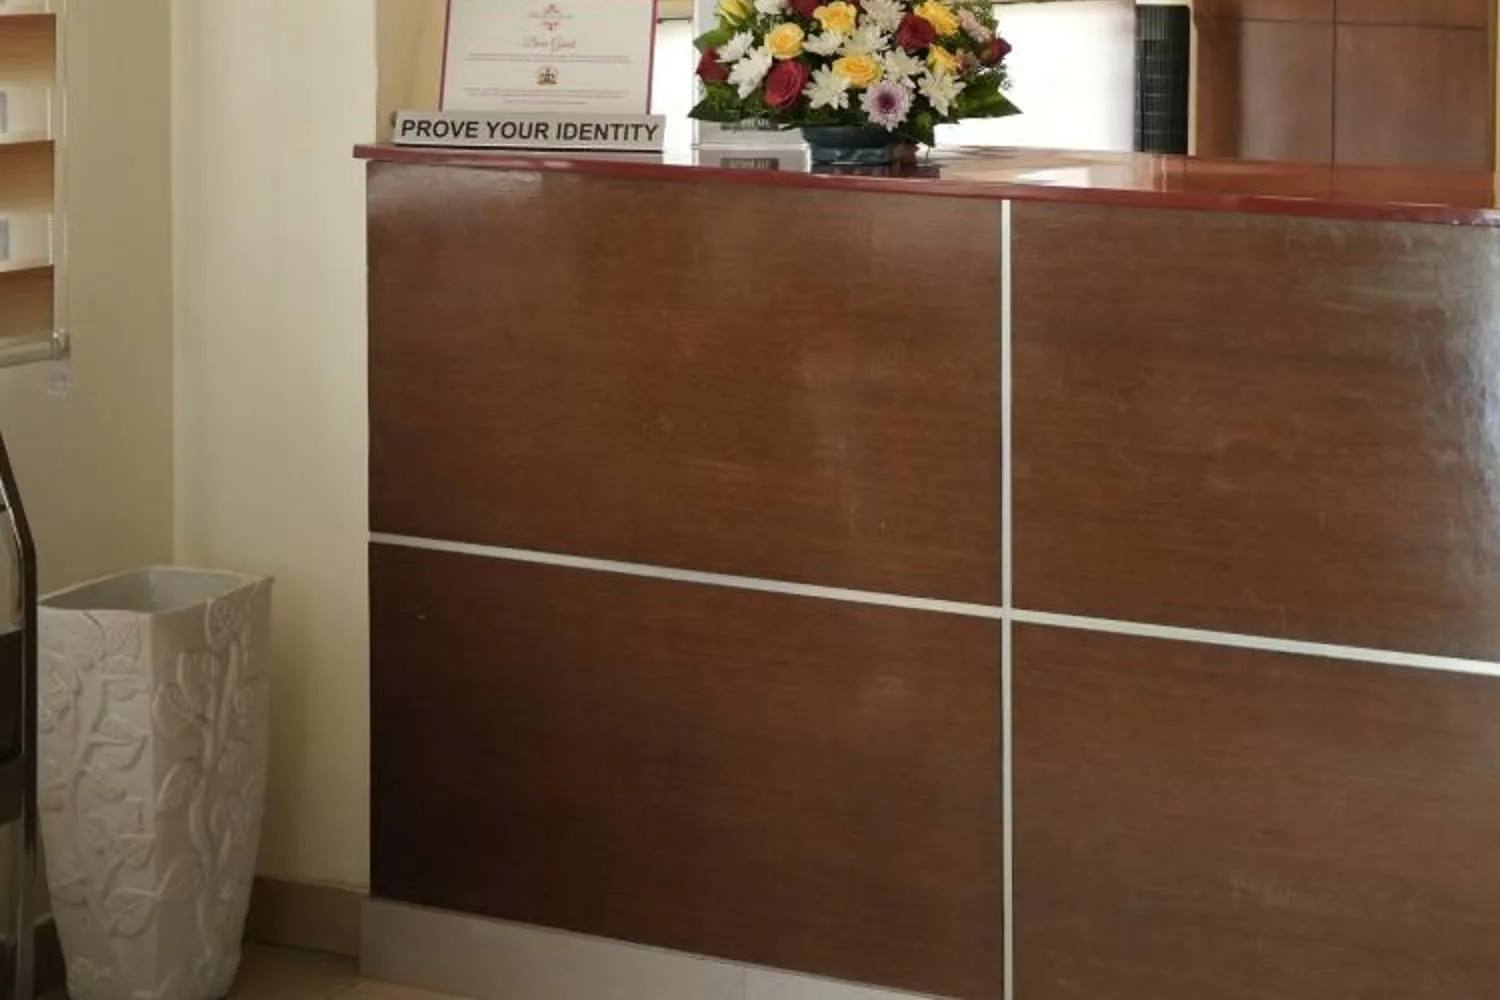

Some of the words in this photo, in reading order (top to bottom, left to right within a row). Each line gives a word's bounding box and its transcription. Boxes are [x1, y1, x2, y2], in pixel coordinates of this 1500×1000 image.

[400, 119, 479, 138] PROVE
[487, 121, 549, 140] YOUR
[556, 123, 659, 142] IDENTITY
